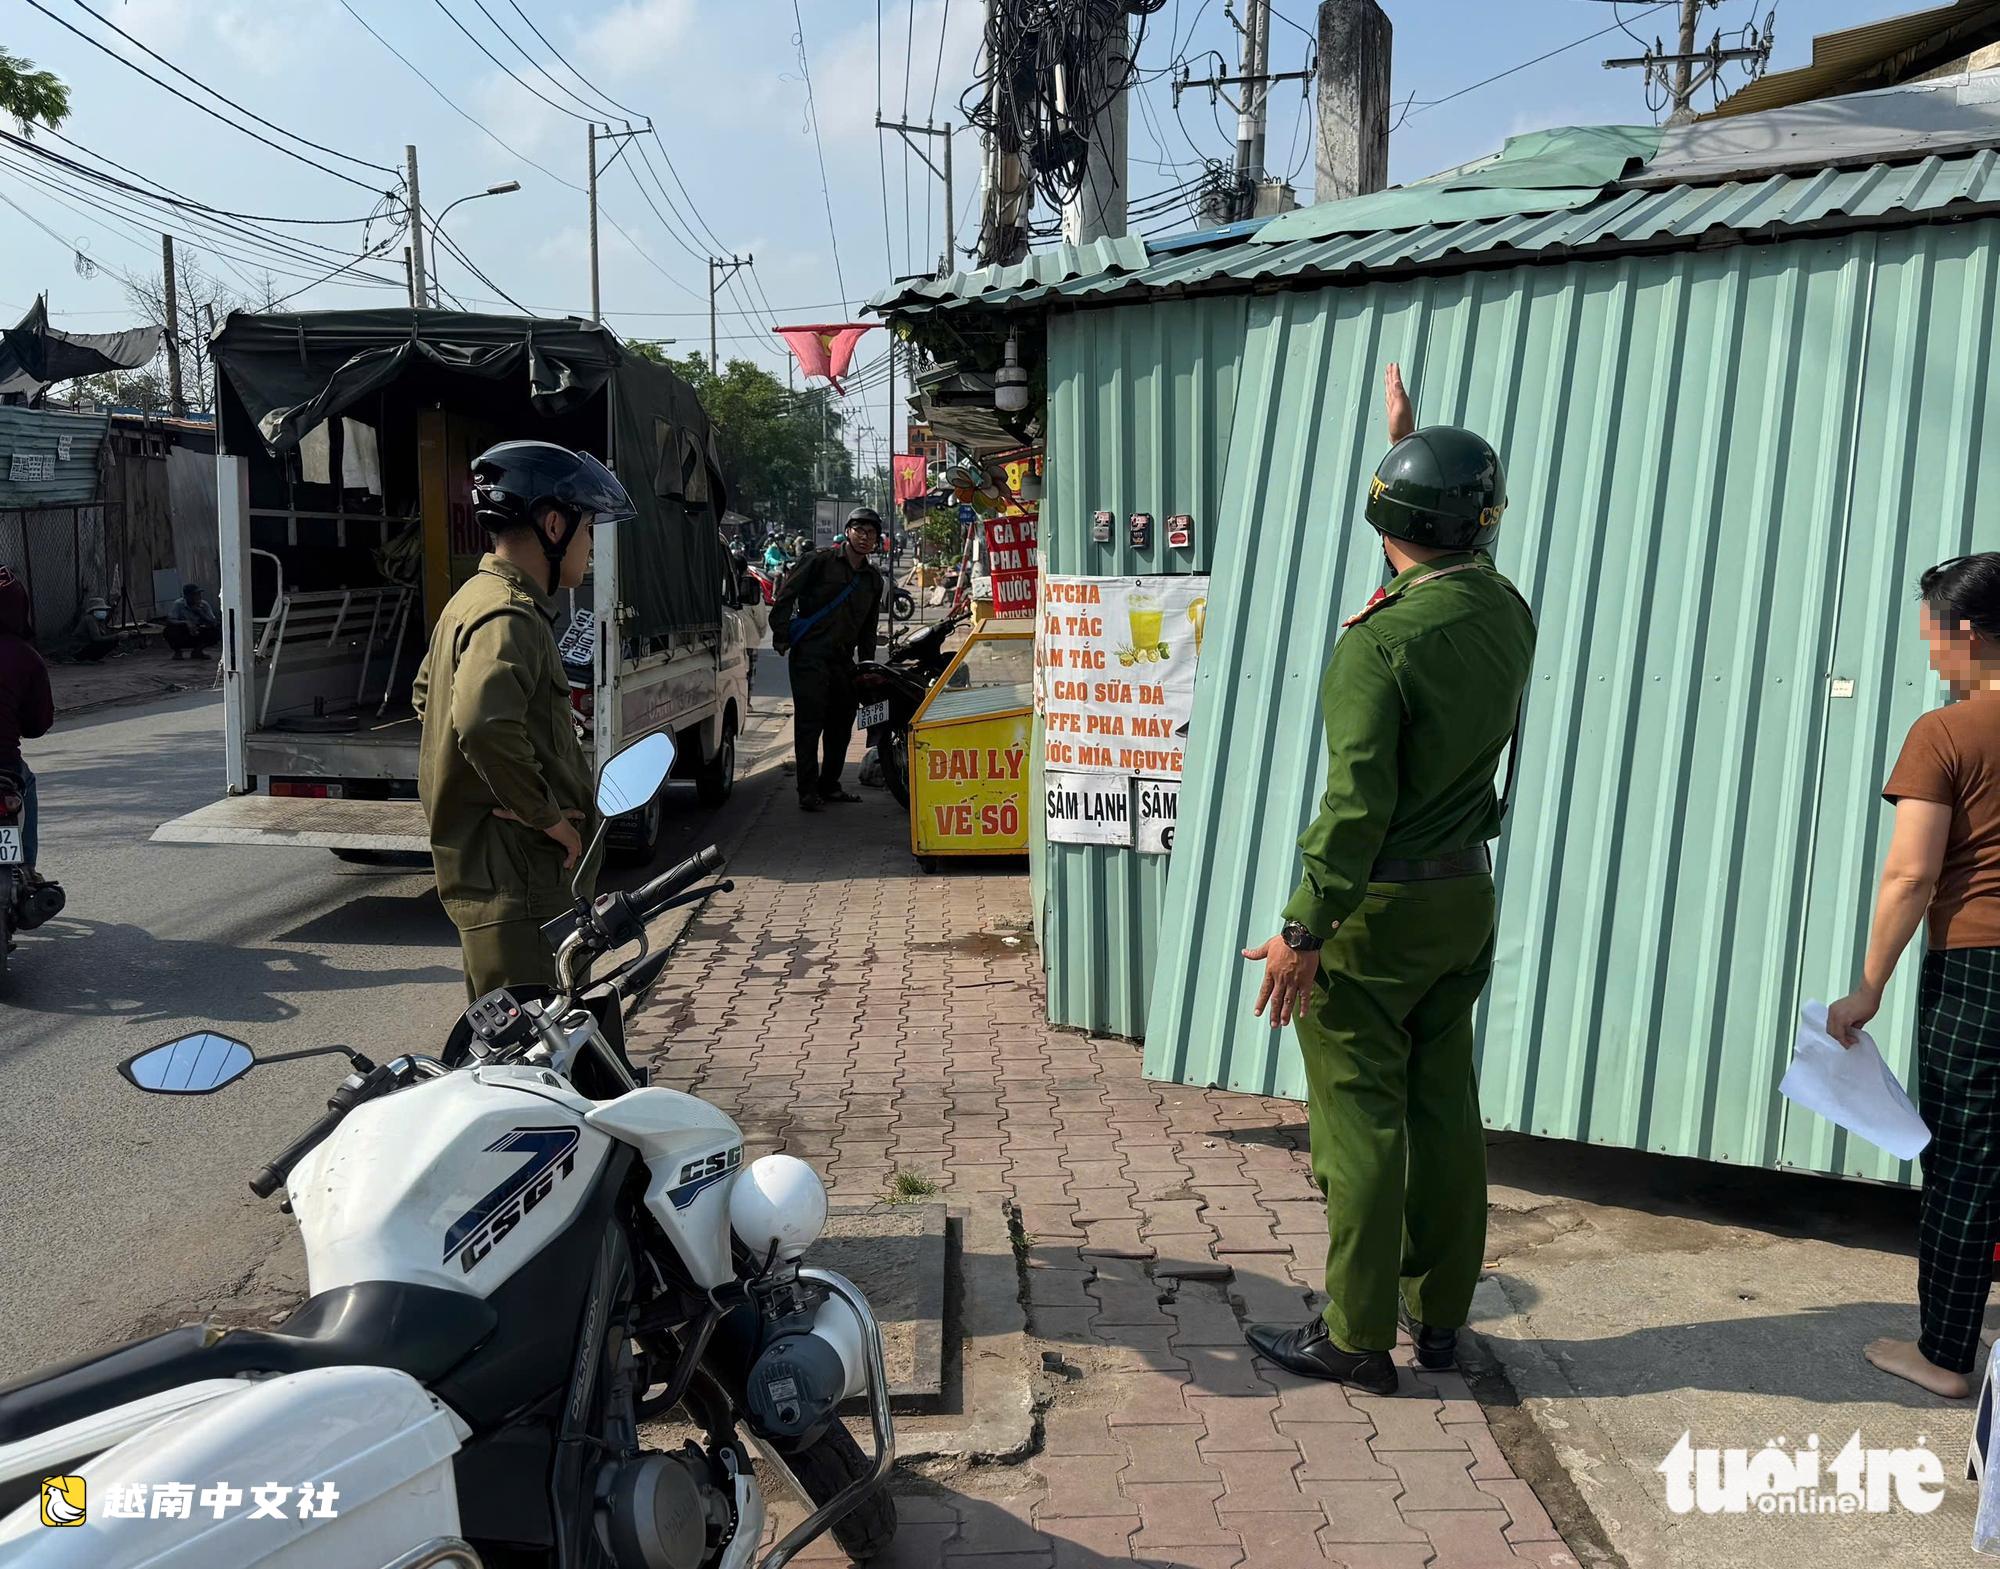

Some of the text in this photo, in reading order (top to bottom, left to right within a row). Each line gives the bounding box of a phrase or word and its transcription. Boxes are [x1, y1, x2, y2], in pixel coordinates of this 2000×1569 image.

[990, 549, 1022, 570] PHA
[1066, 608, 1102, 637] TẮC
[1069, 641, 1106, 670] TẮC
[1054, 679, 1165, 705] CAO SỮA ĐÁ
[1087, 714, 1124, 736] PHA
[1131, 713, 1173, 738] MÁY
[987, 742, 1024, 779] LÝ
[1078, 742, 1112, 766] MÍA
[934, 793, 1019, 836] VÉ SỐ
[1047, 783, 1127, 827] SÂM LẠNH
[1141, 784, 1177, 820] SÂM
[460, 1146, 579, 1274] CSGT
